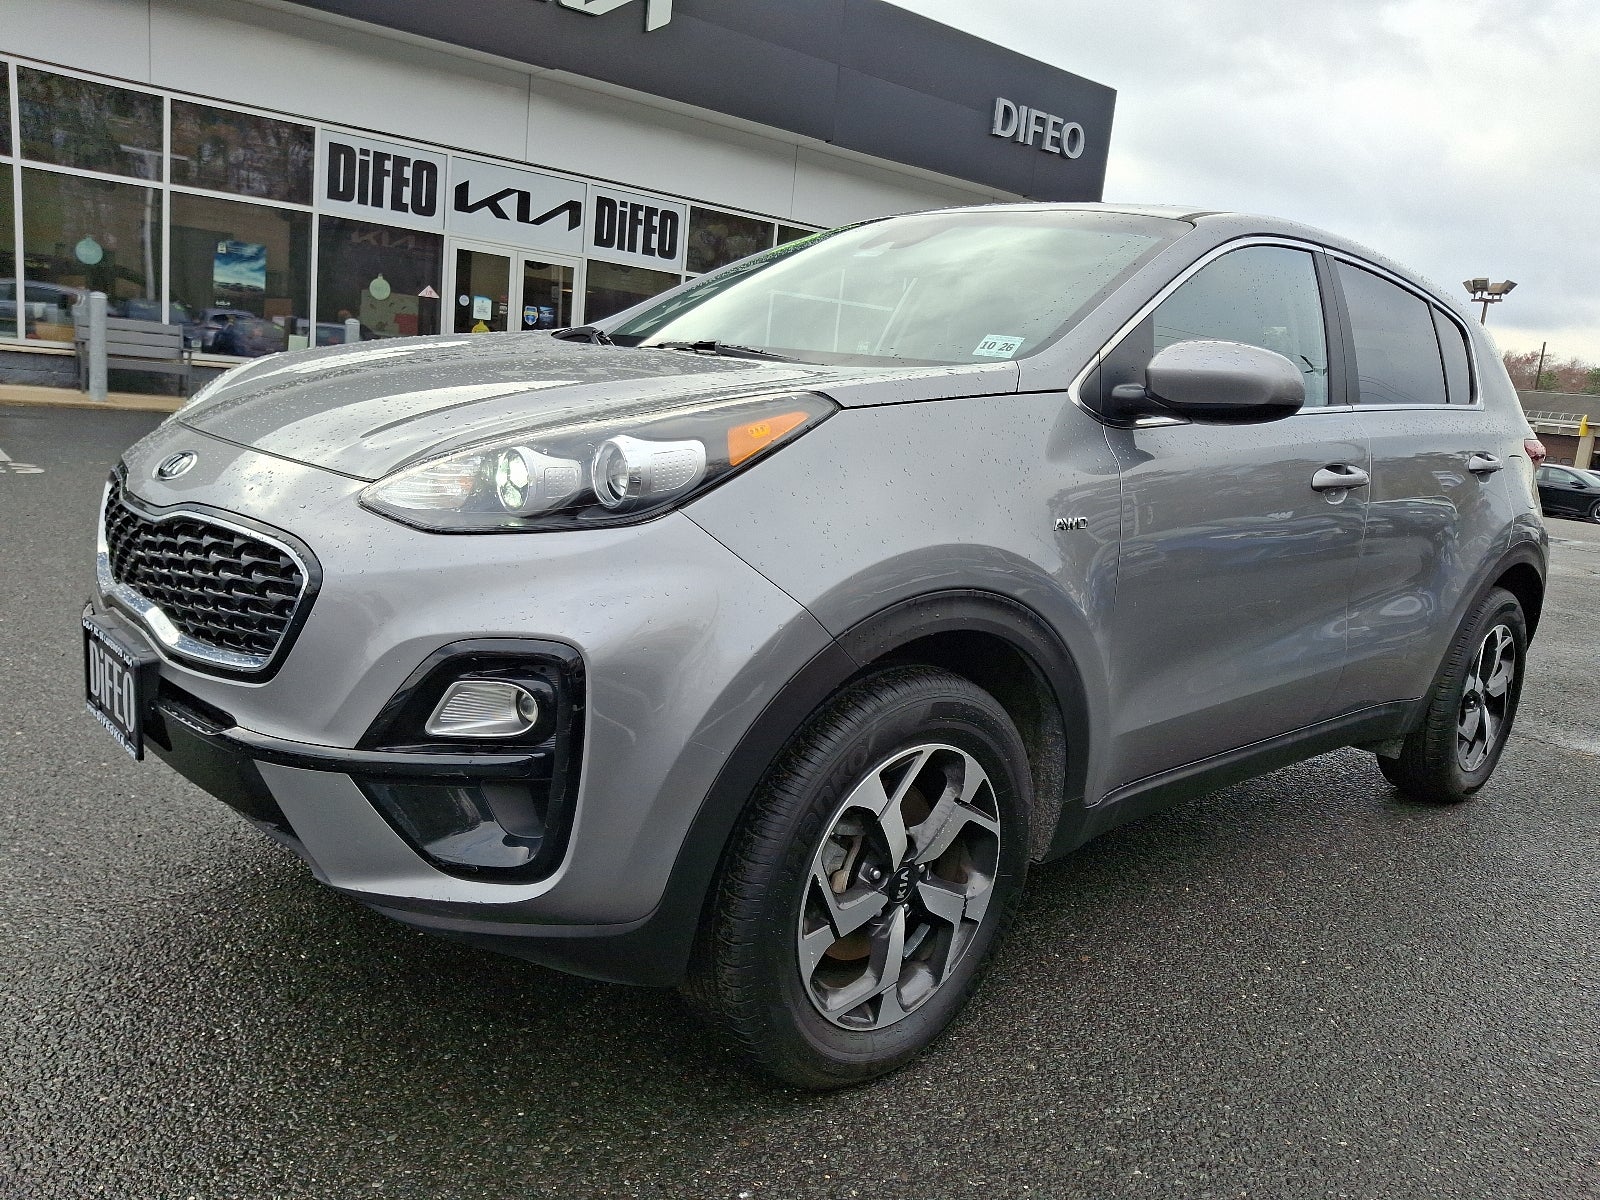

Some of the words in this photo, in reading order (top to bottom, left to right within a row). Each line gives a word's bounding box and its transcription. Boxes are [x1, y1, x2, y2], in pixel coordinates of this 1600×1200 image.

[992, 97, 1085, 159] DIFEO
[327, 141, 438, 217] DiFEO
[454, 180, 583, 232] KIA
[594, 195, 679, 260] DiFEO
[980, 341, 997, 350] 10
[997, 343, 1015, 352] 26
[1053, 516, 1089, 532] AWD
[89, 639, 136, 733] DiFEO
[896, 869, 910, 899] KIA
